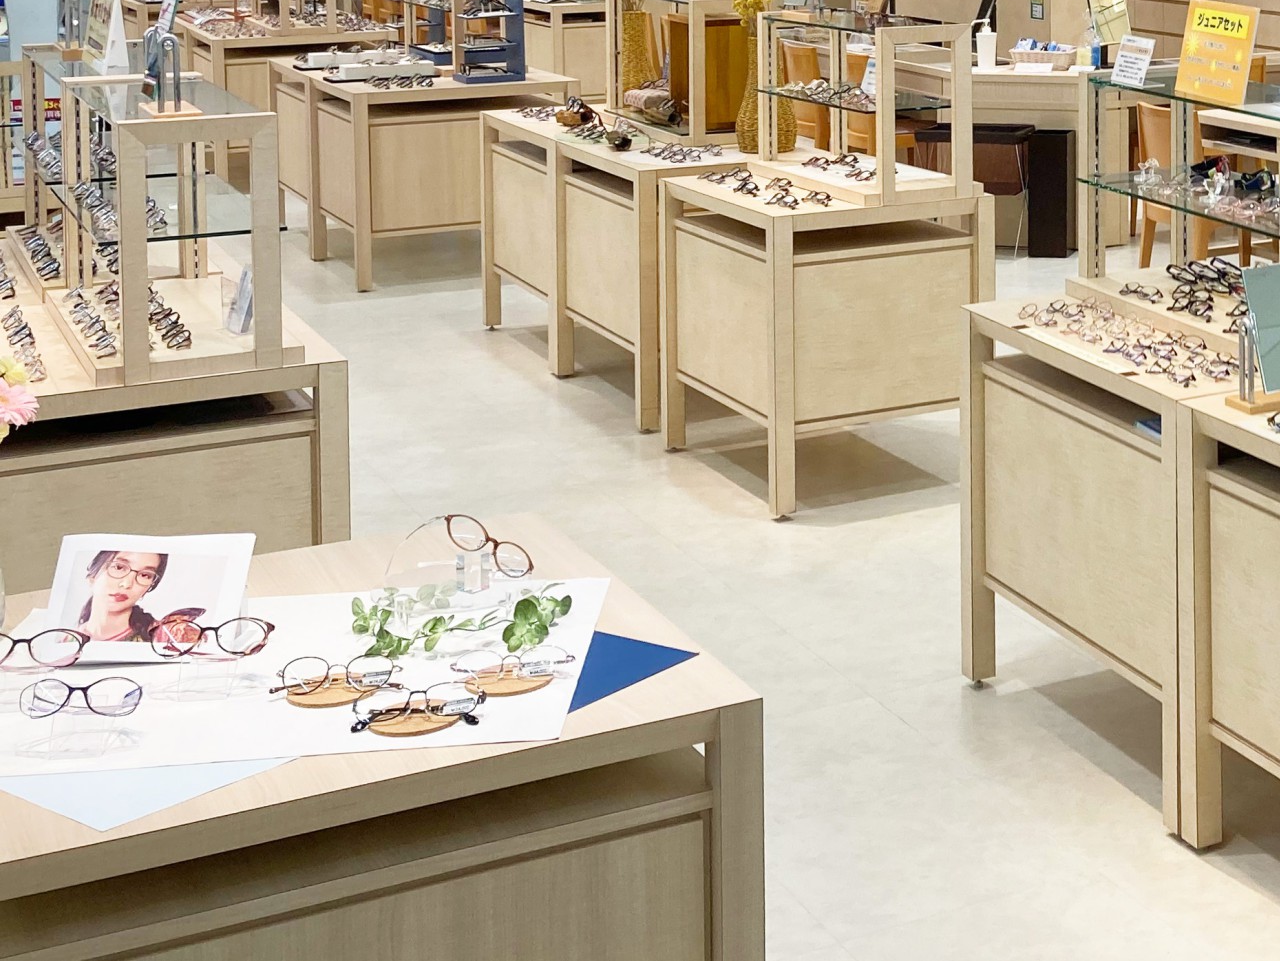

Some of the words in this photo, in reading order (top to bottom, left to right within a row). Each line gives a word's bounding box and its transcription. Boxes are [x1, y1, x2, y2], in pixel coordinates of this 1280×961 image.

[1197, 13, 1244, 33] ジュニアセット
